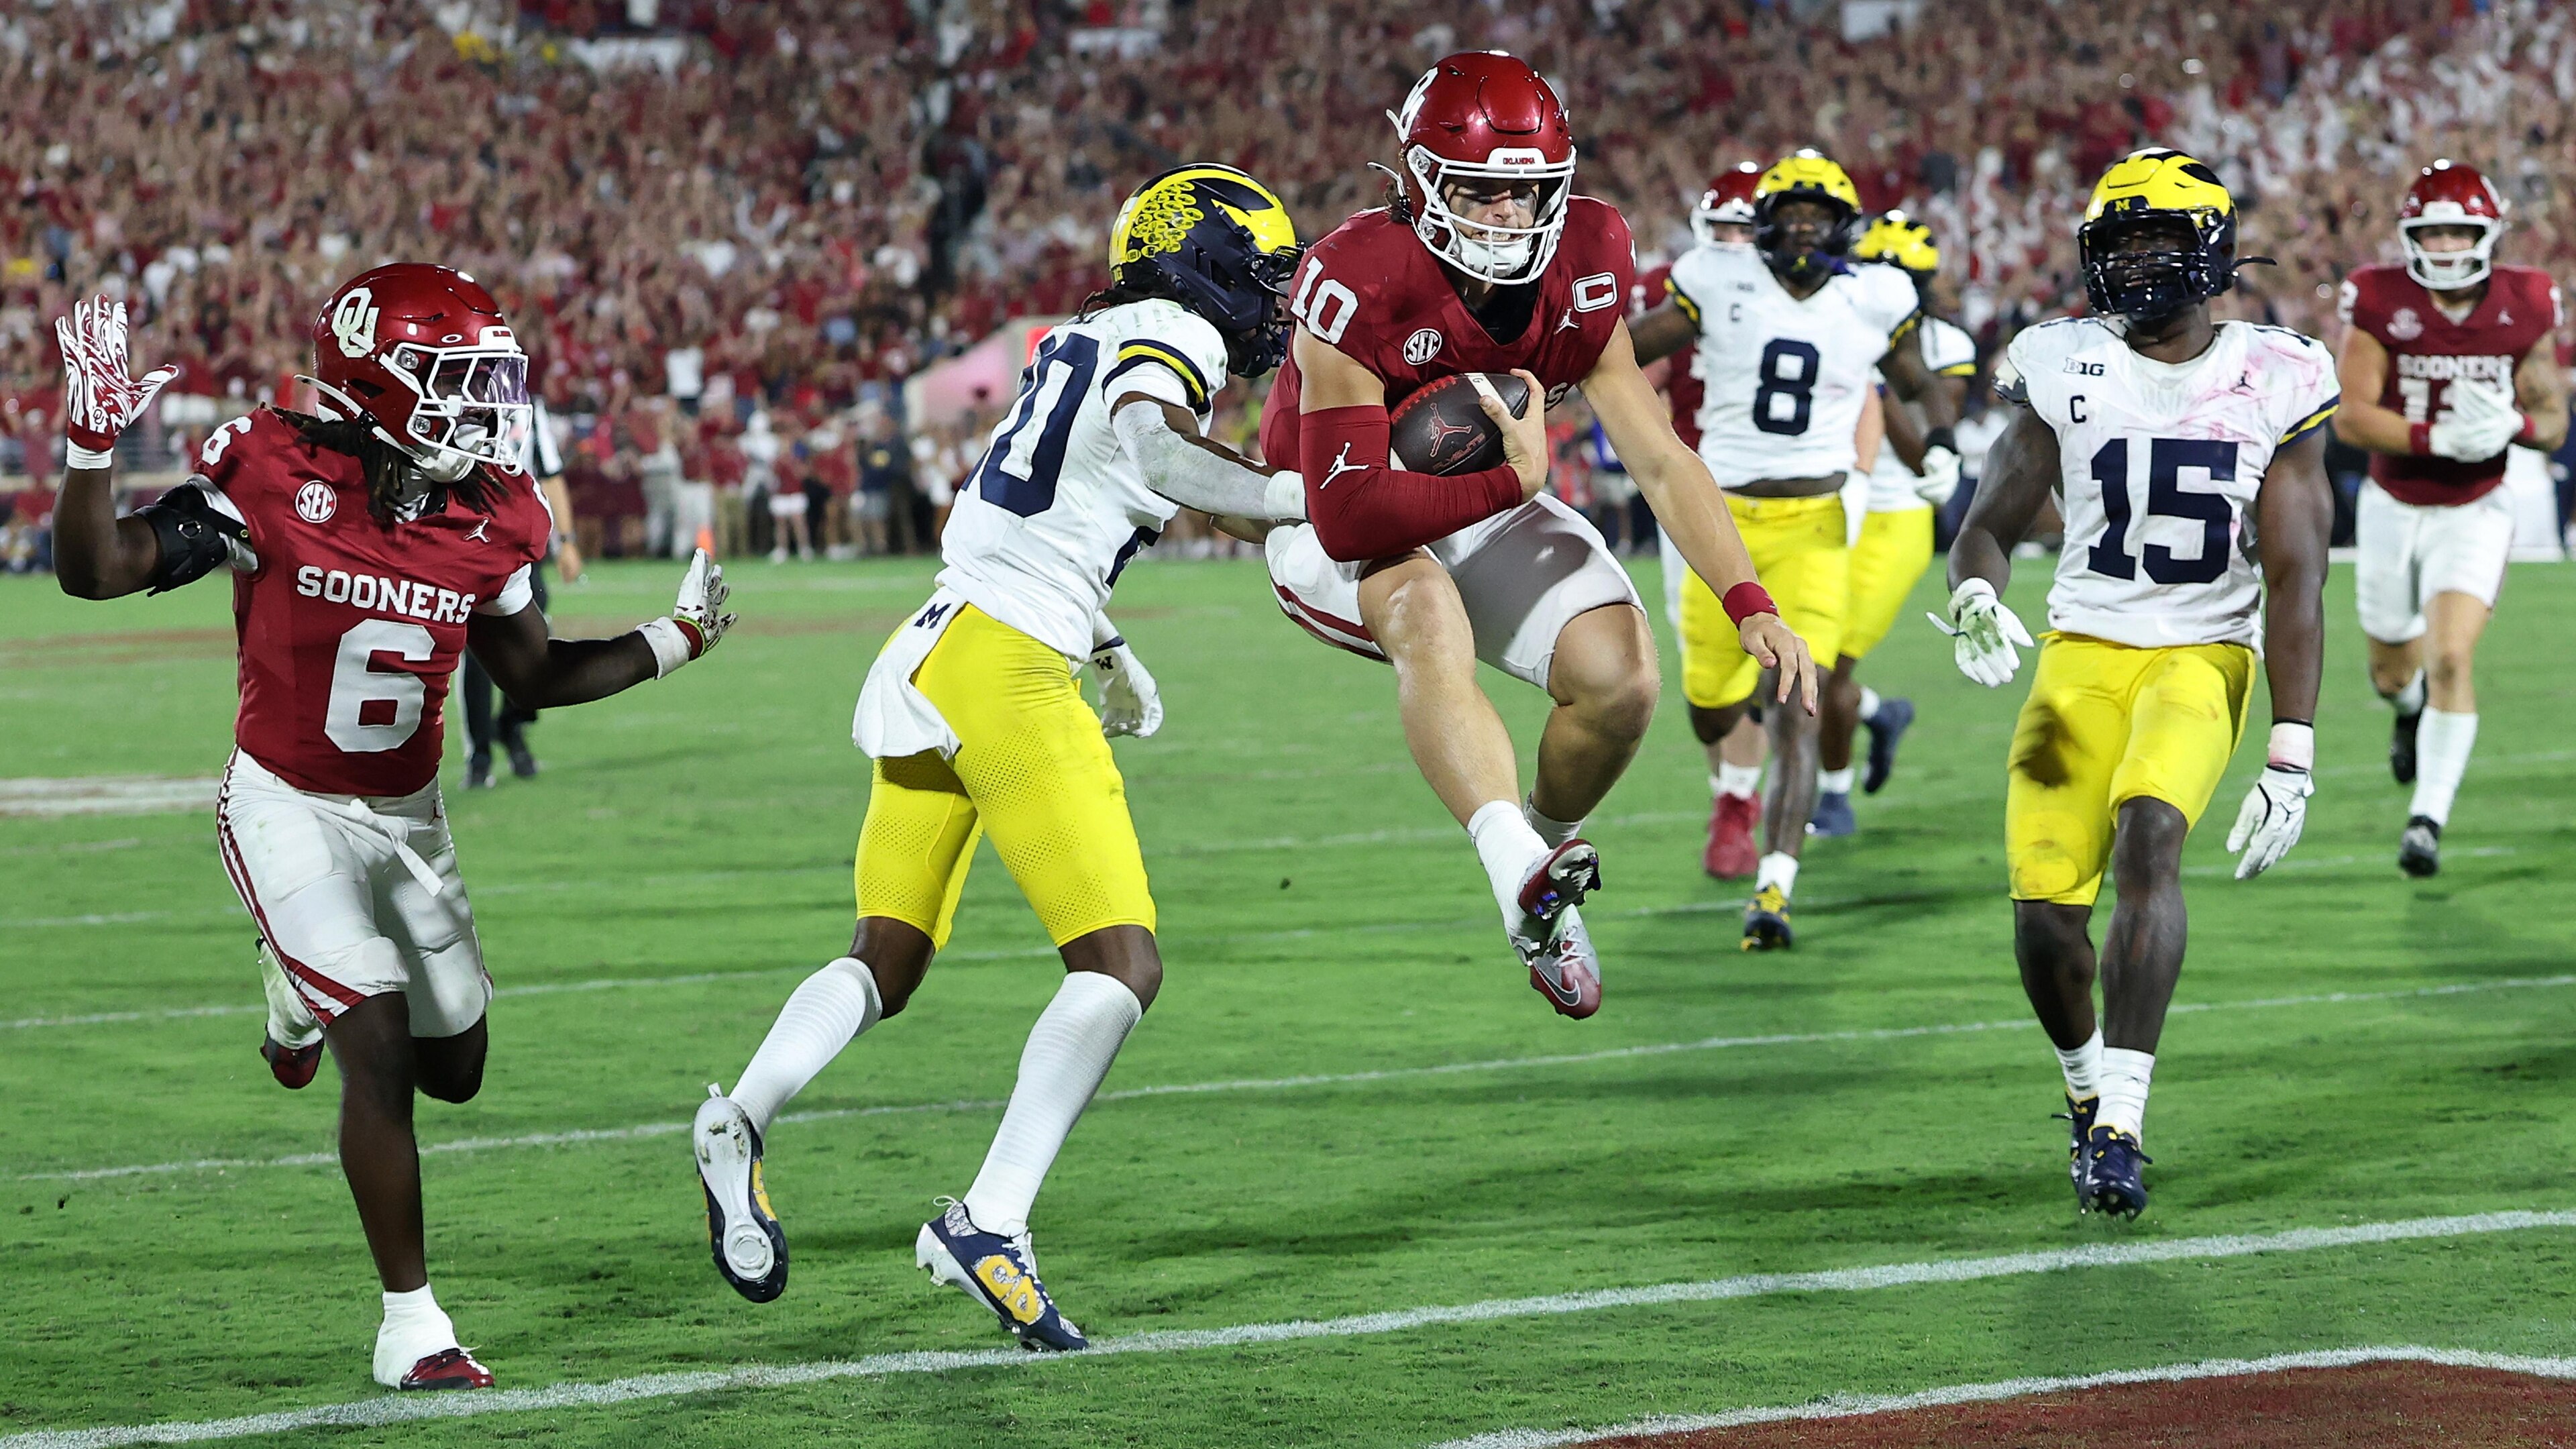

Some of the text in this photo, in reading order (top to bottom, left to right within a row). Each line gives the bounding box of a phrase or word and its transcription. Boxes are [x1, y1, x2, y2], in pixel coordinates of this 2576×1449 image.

[1503, 157, 1536, 165] OKLAHOMA
[2114, 199, 2131, 212] M
[1290, 256, 1359, 345] 10
[1574, 274, 1615, 311] C
[331, 287, 380, 358] OU
[1407, 331, 1439, 363] SEC
[1753, 338, 1820, 436] 8
[2070, 394, 2087, 424] C
[202, 416, 253, 466] 6
[299, 482, 335, 521] SEC
[2088, 437, 2239, 584] 15
[297, 565, 476, 624] SOONERS
[914, 603, 952, 629] M
[324, 618, 436, 753] 6
